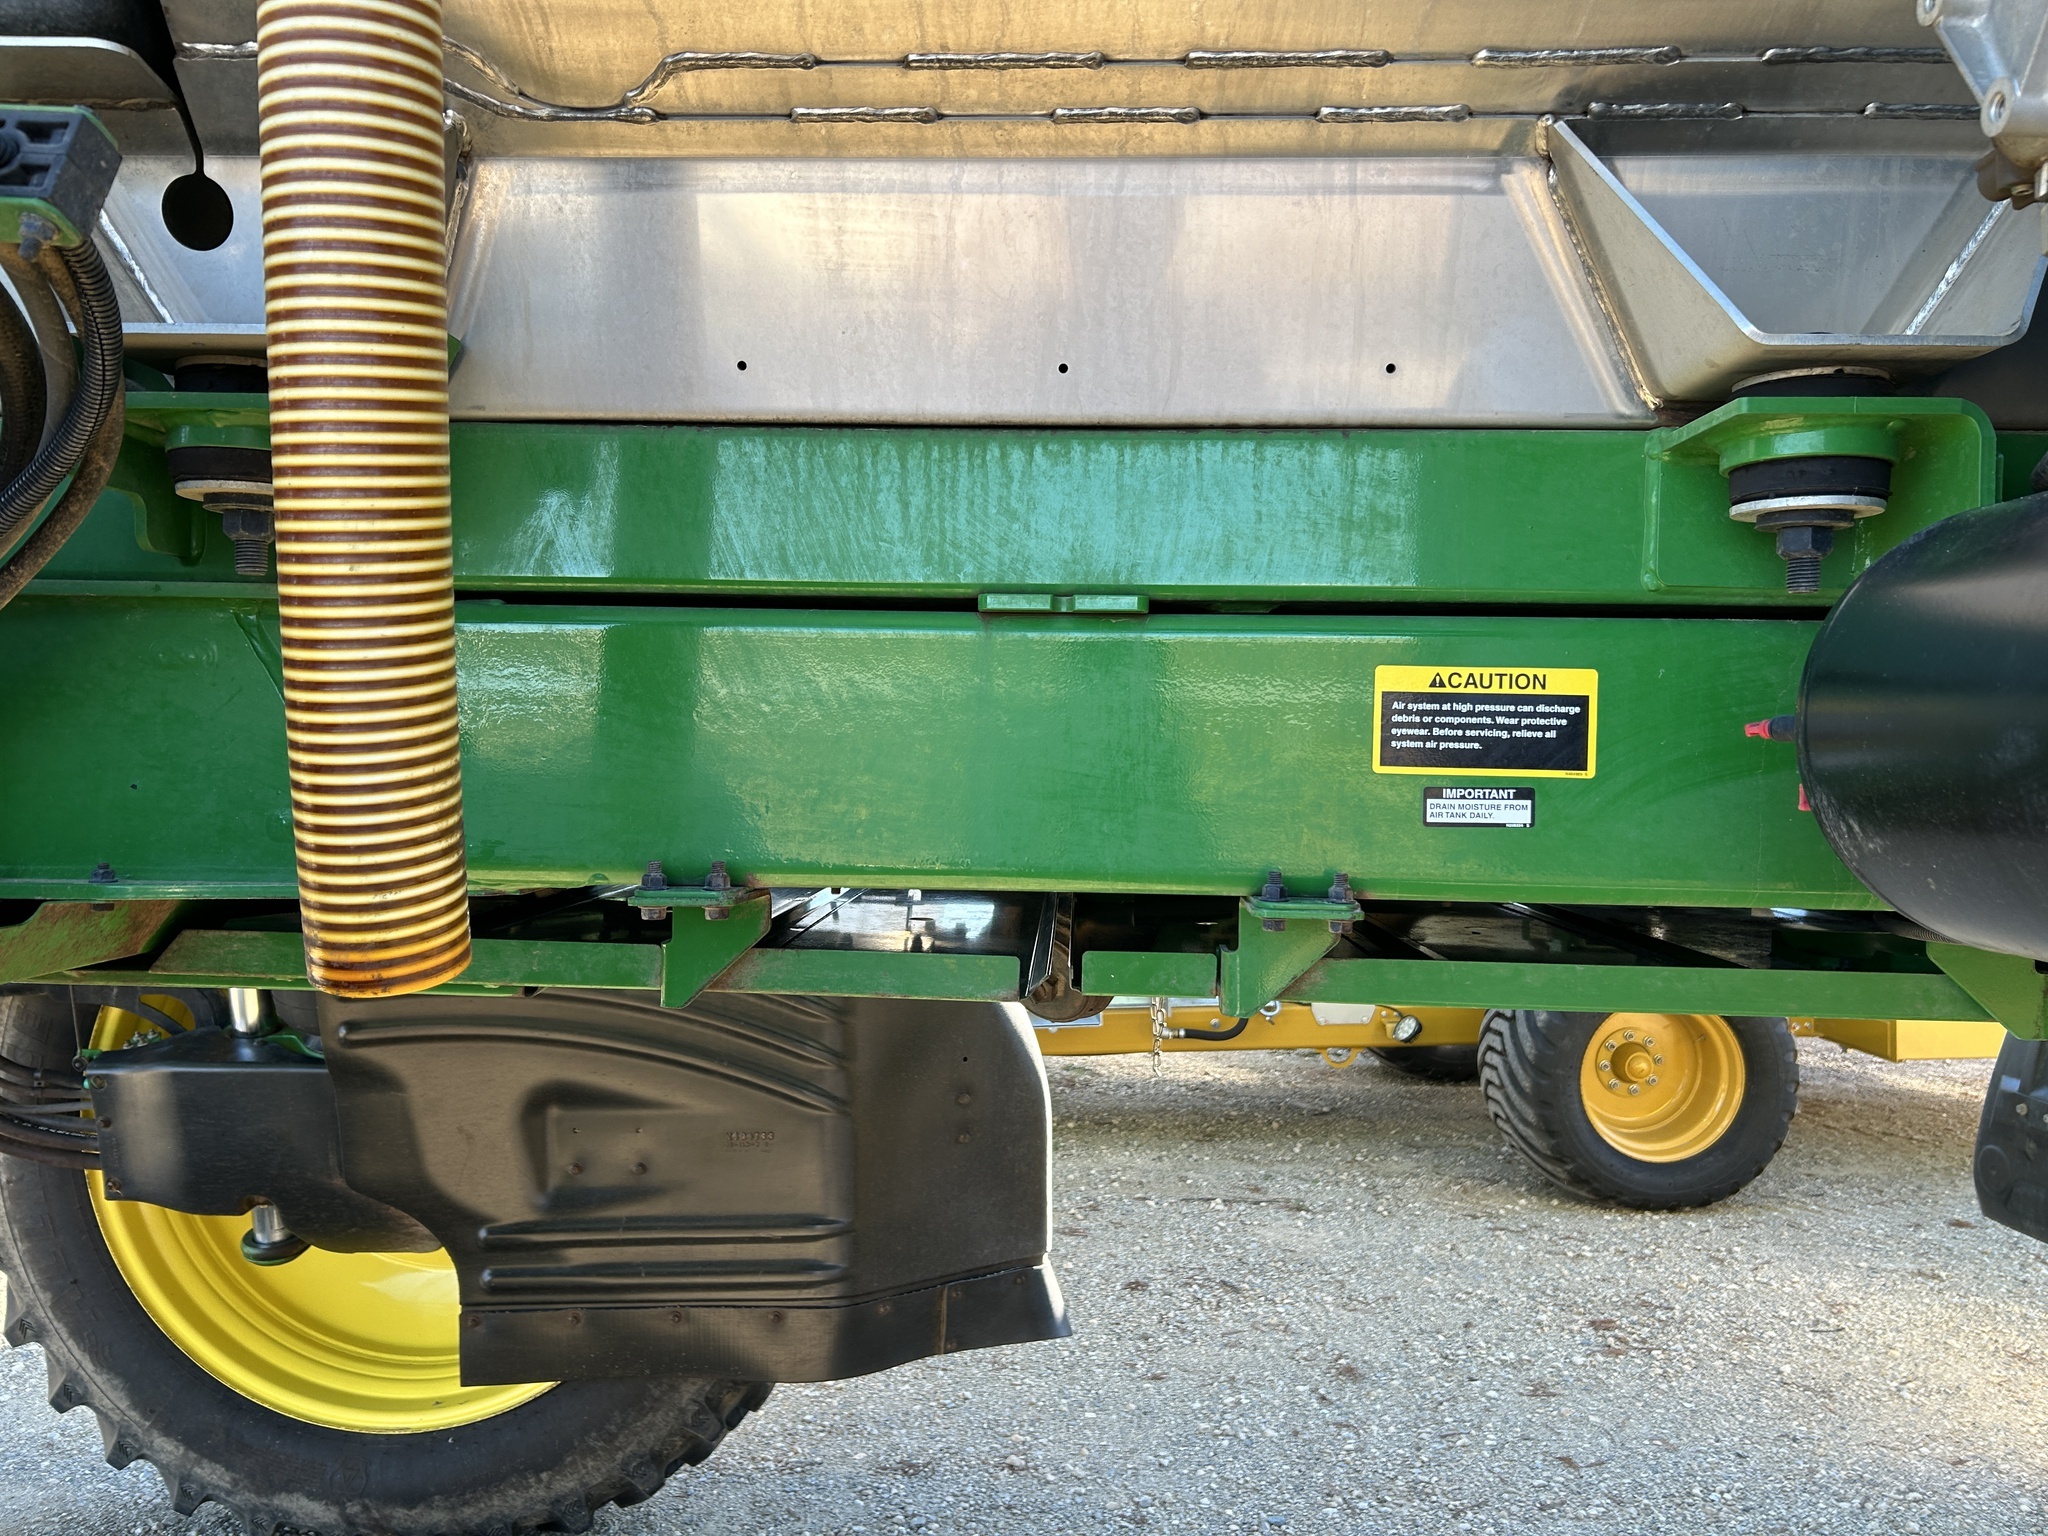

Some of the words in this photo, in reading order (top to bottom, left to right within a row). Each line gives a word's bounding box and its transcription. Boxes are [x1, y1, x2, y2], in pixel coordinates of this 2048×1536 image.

[1447, 672, 1547, 690] CAUTION
[1391, 701, 1406, 710] Air
[1407, 702, 1440, 711] system
[1441, 702, 1451, 711] at
[1452, 702, 1473, 713] high
[1475, 704, 1515, 713] pressure
[1536, 704, 1581, 715] discharge
[1391, 714, 1420, 723] debris
[1434, 715, 1494, 725] components.
[1495, 715, 1520, 725] Wear
[1521, 717, 1568, 726] protective
[1391, 728, 1431, 737] eyewear.
[1432, 727, 1463, 736] Before
[1465, 728, 1511, 739] servicing,
[1512, 729, 1543, 738] relieve
[1544, 730, 1557, 738] all
[1390, 740, 1424, 749] system
[1425, 740, 1438, 748] air
[1439, 741, 1483, 750] pressure.
[1442, 788, 1517, 799] IMPORTANT
[1457, 803, 1502, 811] MOISTURE
[1429, 811, 1443, 819] AIR
[1445, 811, 1467, 819] TANK
